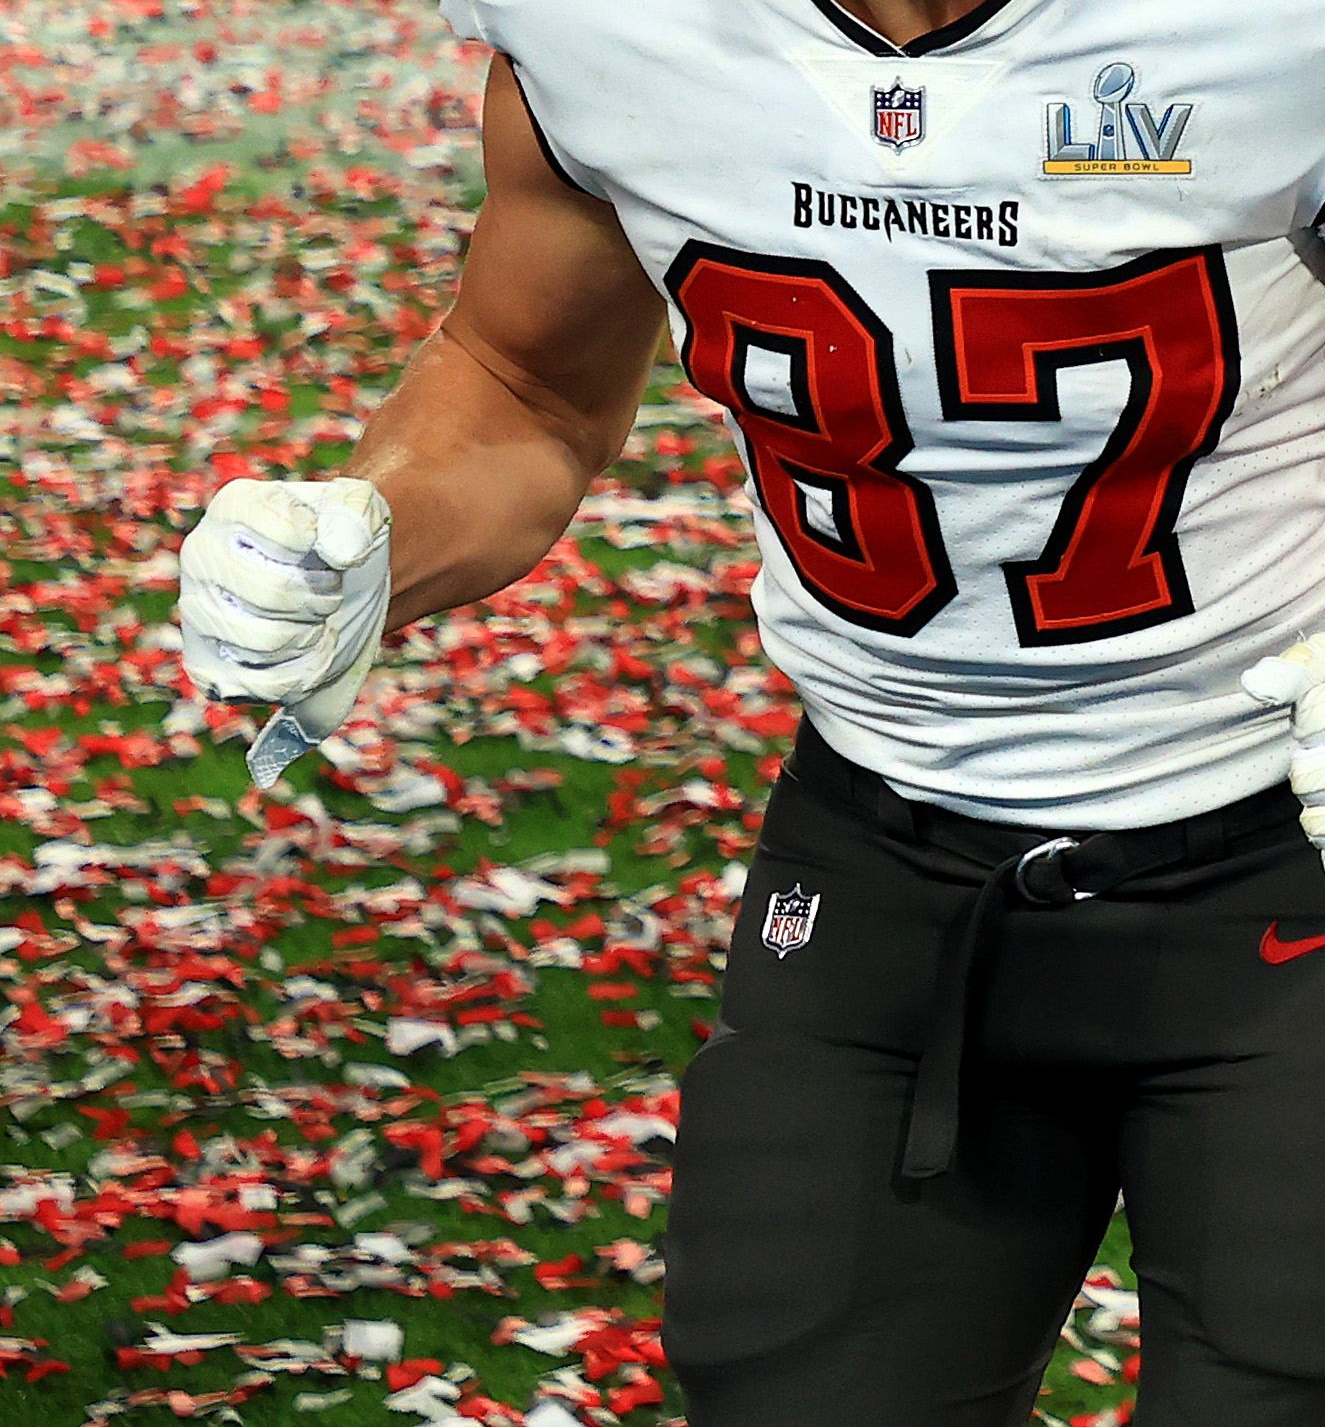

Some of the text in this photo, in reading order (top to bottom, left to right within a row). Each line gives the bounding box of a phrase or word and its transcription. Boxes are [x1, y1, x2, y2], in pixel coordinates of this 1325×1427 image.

[877, 111, 917, 140] NFL
[1074, 162, 1160, 172] SUPER BOWL
[791, 181, 1020, 247] BUCCANEERS
[663, 239, 1242, 648] 87
[769, 917, 802, 944] NFL
